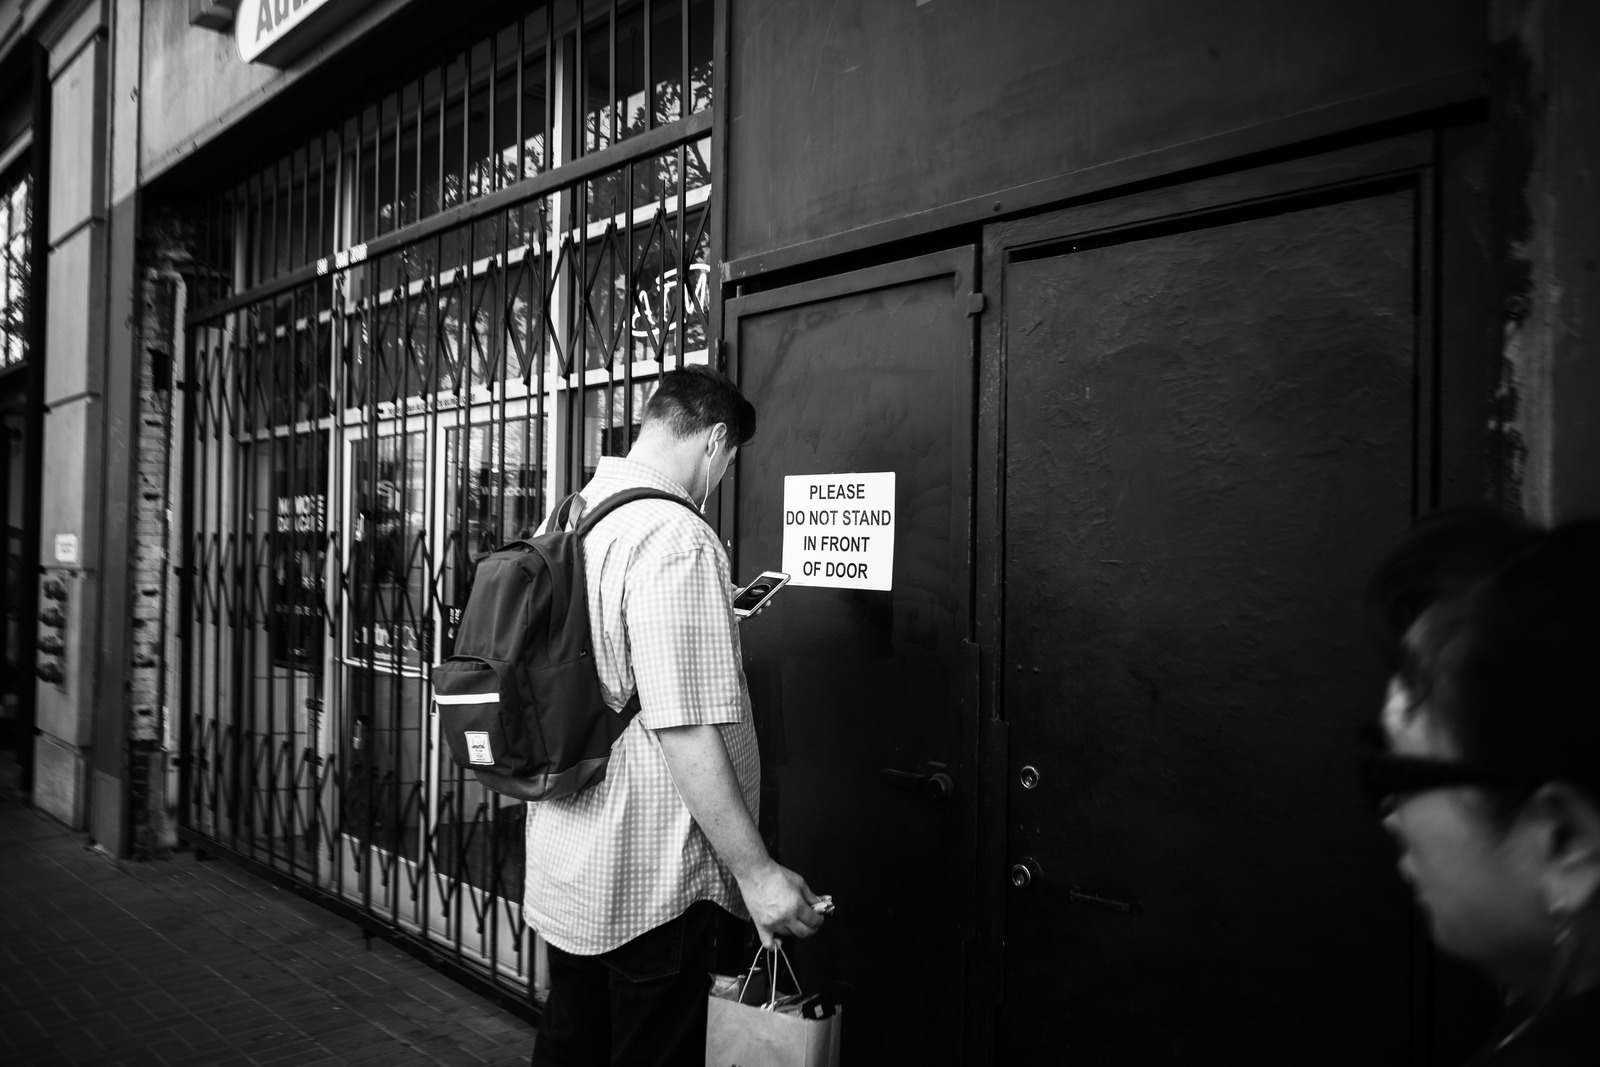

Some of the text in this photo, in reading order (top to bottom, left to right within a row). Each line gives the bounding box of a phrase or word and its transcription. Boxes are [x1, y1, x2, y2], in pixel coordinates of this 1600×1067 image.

[255, 0, 309, 41] Au
[631, 272, 708, 330] ATM
[809, 483, 866, 500] PLEASE
[786, 509, 892, 526] DO NOT STAND
[803, 535, 871, 553] IN FRONT
[803, 560, 869, 579] OF DOOR
